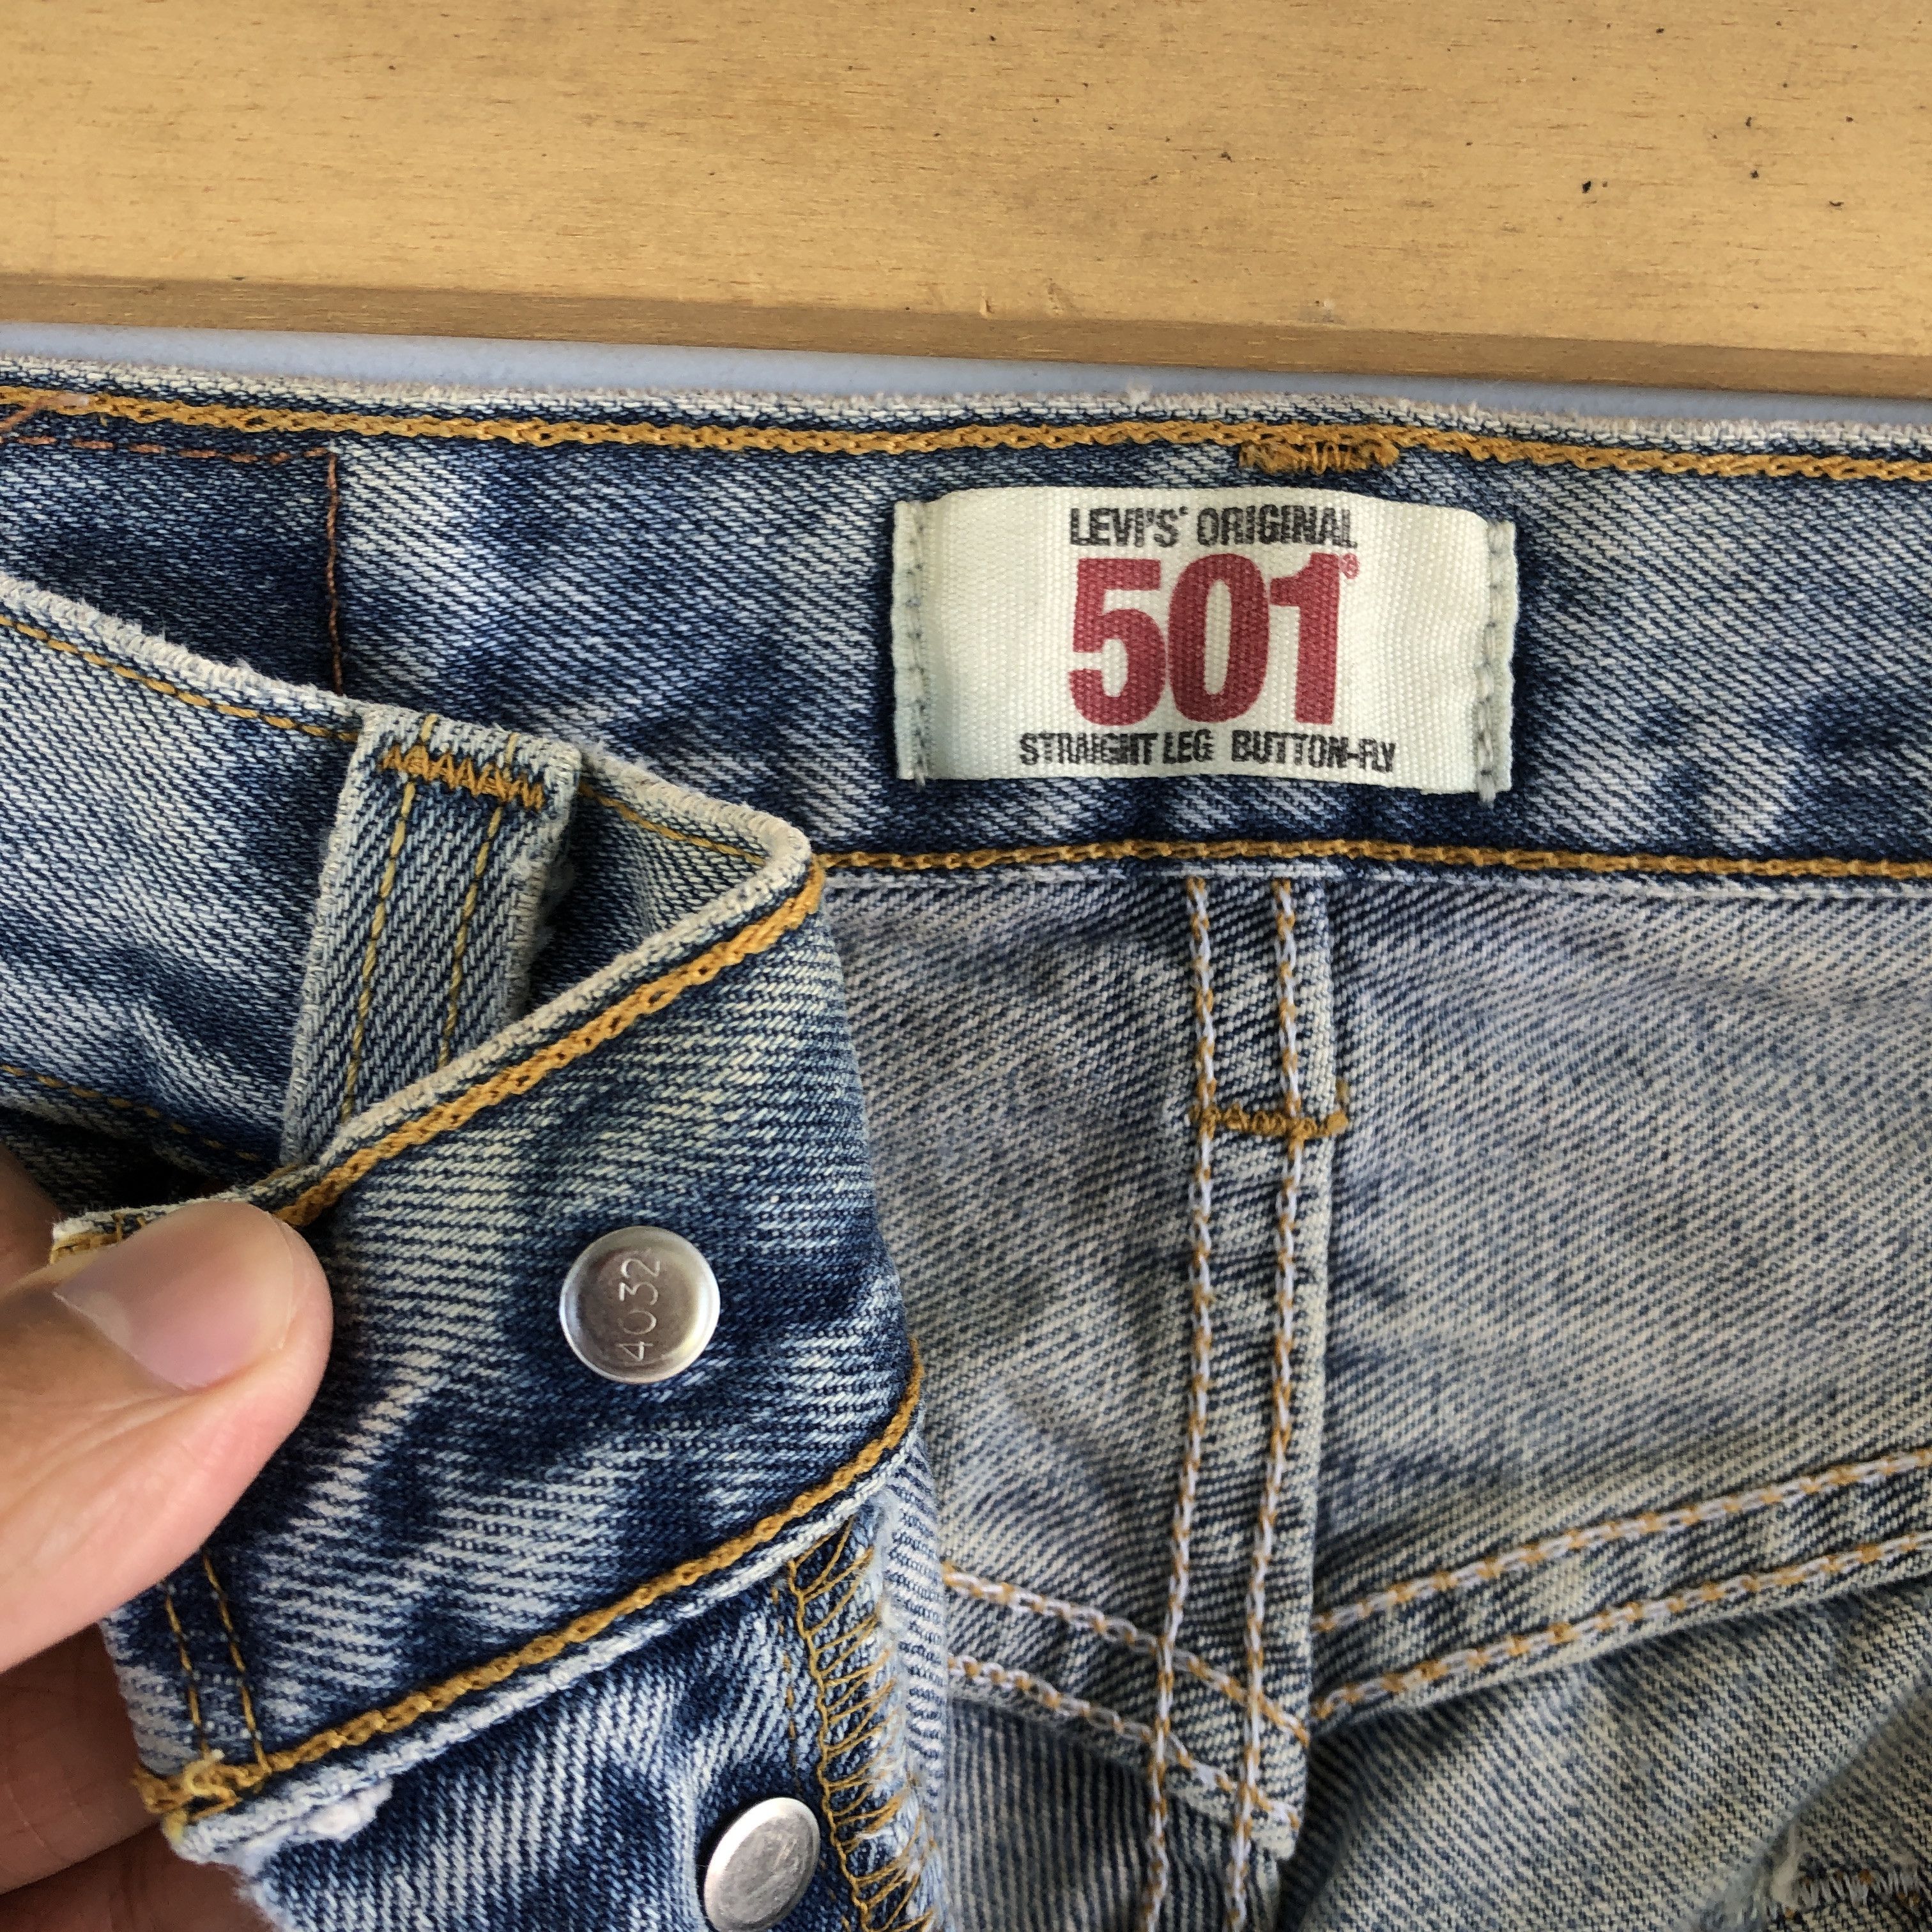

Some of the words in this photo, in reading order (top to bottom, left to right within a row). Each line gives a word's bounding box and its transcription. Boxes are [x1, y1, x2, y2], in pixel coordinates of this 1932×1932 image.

[1197, 504, 1358, 549] ORIGINAL
[1230, 730, 1396, 773] BUTTON-FLY
[615, 1257, 661, 1362] 4032
